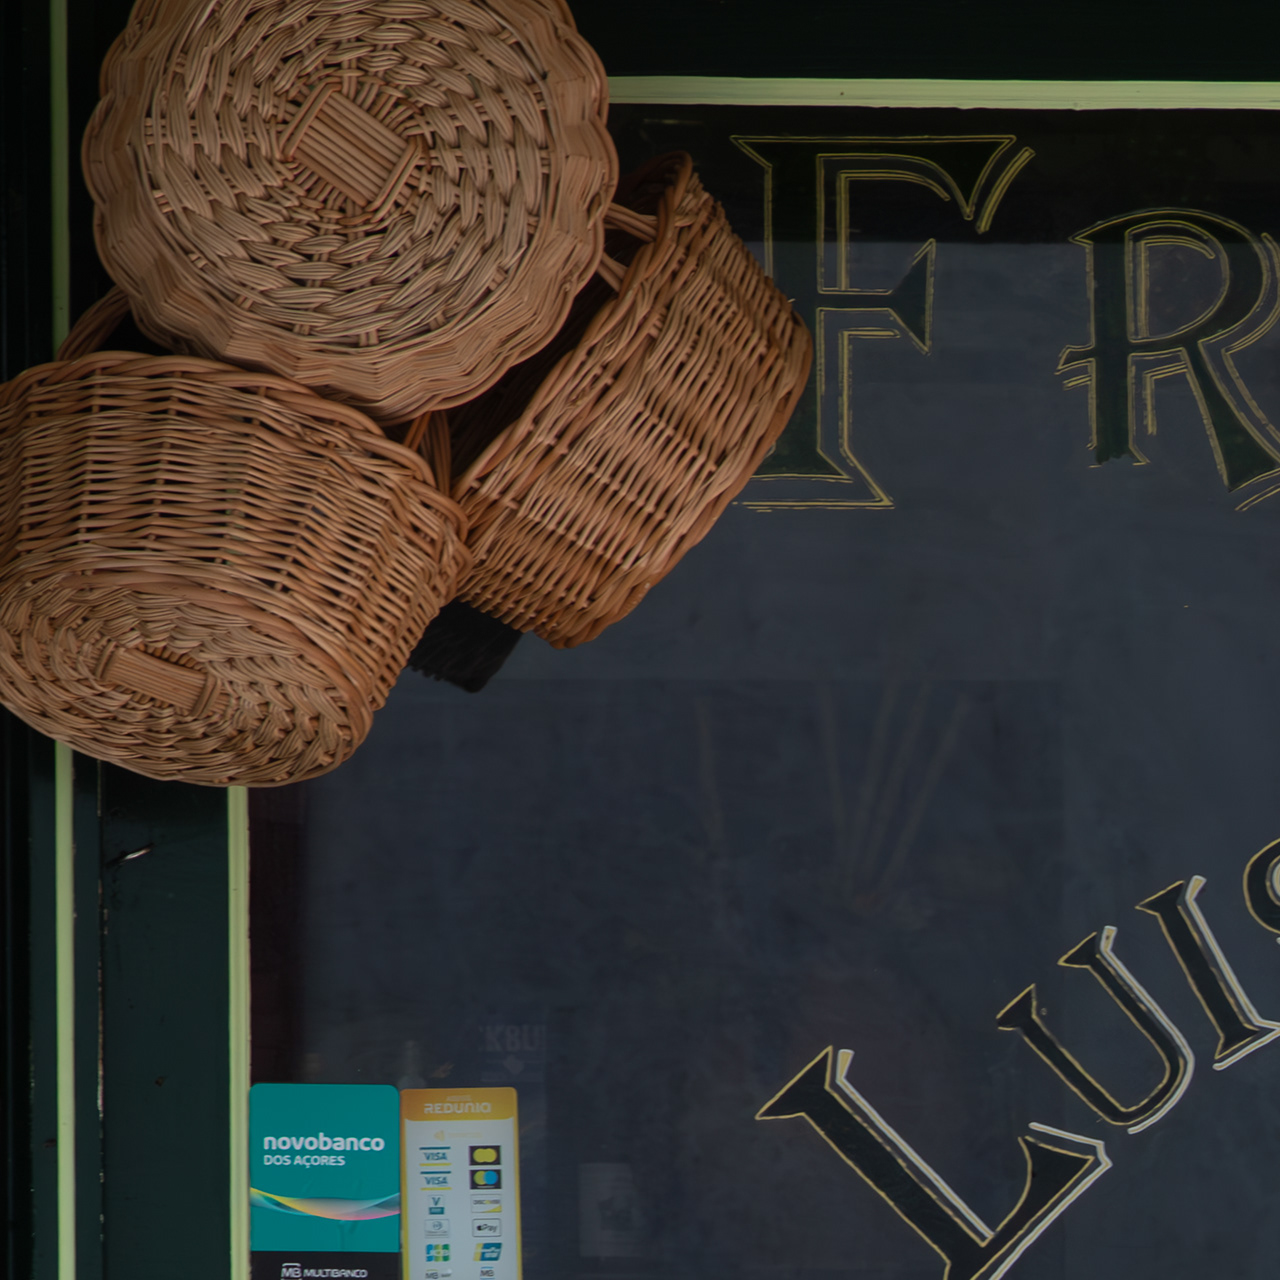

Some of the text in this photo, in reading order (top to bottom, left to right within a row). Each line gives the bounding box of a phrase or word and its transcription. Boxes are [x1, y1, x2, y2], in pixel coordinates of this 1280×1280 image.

[263, 1133, 385, 1151] novobanco
[263, 1155, 346, 1168] DOS AÇORES
[424, 1152, 448, 1161] VISA
[425, 1177, 449, 1185] VISA
[303, 1268, 368, 1278] MULTIBANCO
